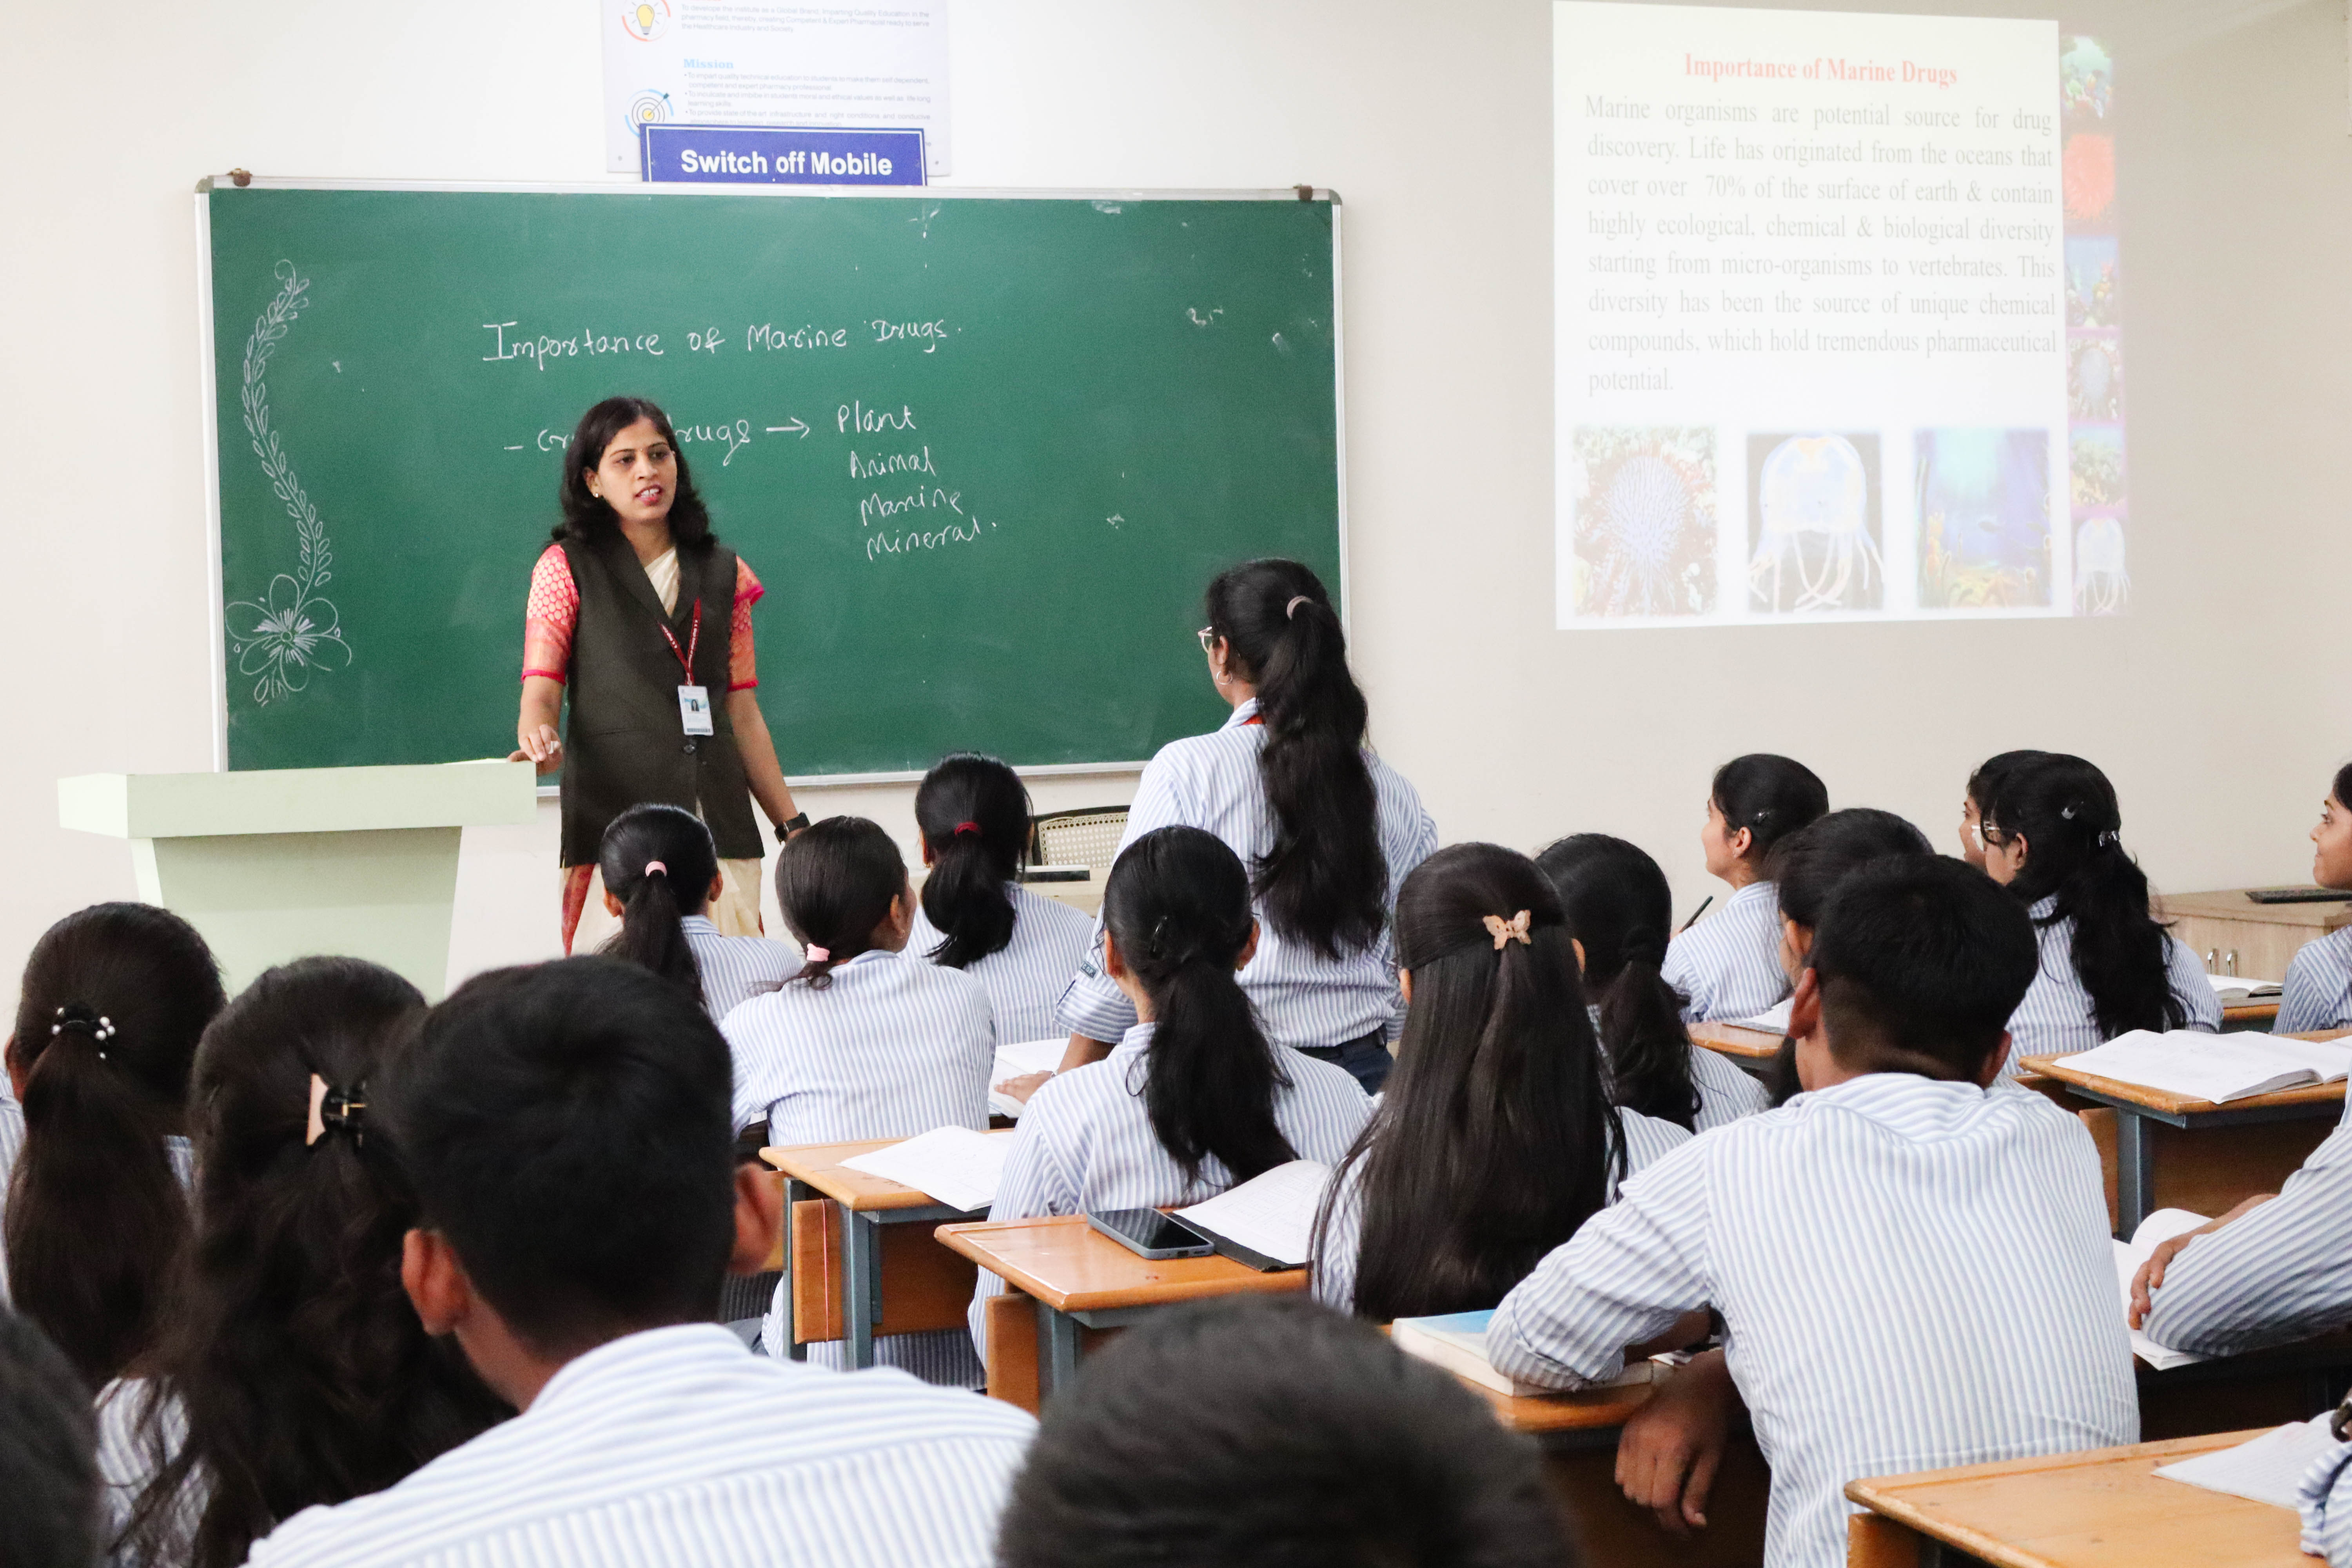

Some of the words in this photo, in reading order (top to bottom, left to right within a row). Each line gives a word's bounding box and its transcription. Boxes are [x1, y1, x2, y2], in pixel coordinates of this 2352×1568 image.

[684, 59, 733, 69] Mission
[1685, 53, 1797, 83] Importance
[1803, 57, 1822, 80] of
[1827, 57, 1895, 81] Marine
[1902, 60, 1957, 90] Drugs
[1585, 94, 1650, 118] Marine
[1665, 98, 1757, 127] organisms
[1772, 107, 1799, 123] are
[1813, 103, 1890, 131] potential
[1904, 110, 1960, 127] source
[1975, 105, 2000, 128] for
[2013, 107, 2053, 137] drug
[681, 149, 768, 174] Switch
[776, 151, 806, 174] off
[811, 152, 893, 176] Mobile
[1588, 132, 1680, 164] discovery.
[1689, 135, 1726, 159] Life
[1735, 136, 1764, 160] has
[1773, 138, 1862, 168] originated
[1872, 139, 1913, 163] from
[1921, 142, 1947, 164] the
[1955, 149, 2013, 165] oceans
[2021, 144, 2053, 167] that
[1588, 179, 1639, 196] cover
[1648, 180, 1688, 197] over
[1705, 174, 1745, 198] 70%
[1755, 176, 1775, 198] of
[1782, 176, 1809, 198] the
[1817, 178, 1881, 200] surface
[1889, 178, 1909, 201] of
[1915, 179, 1958, 201] earth
[1967, 180, 1983, 202] &
[1991, 181, 2054, 204] contain
[1588, 210, 1646, 241] highly
[1767, 214, 1846, 238] chemical
[1857, 215, 1872, 238] &
[1883, 216, 1970, 245] biological
[1980, 218, 2054, 247] diversity
[1588, 249, 1657, 279] starting
[1668, 250, 1710, 274] from
[1721, 251, 1872, 281] micro-organisms
[1883, 257, 1898, 276] to
[1908, 254, 2007, 277] vertebrates.
[2018, 255, 2055, 278] This
[1588, 289, 1668, 319] diversity
[1680, 289, 1710, 313] has
[1722, 289, 1763, 313] been
[1775, 290, 1802, 313] the
[1813, 297, 1870, 314] source
[1882, 291, 1902, 314] of
[1911, 291, 1969, 321] unique
[1980, 292, 2056, 315] chemical
[483, 321, 664, 371] Importance
[687, 327, 725, 353] of
[747, 323, 847, 351] Marine
[1588, 328, 1699, 358] compounds,
[1708, 328, 1762, 352] which
[1770, 328, 1809, 352] hold
[1817, 328, 1919, 352] tremendous
[1926, 329, 2056, 359] pharmaceutical
[1588, 367, 1673, 397] potential.
[838, 400, 916, 433] Plant
[667, 414, 750, 466] rugs
[850, 445, 936, 479] Animal
